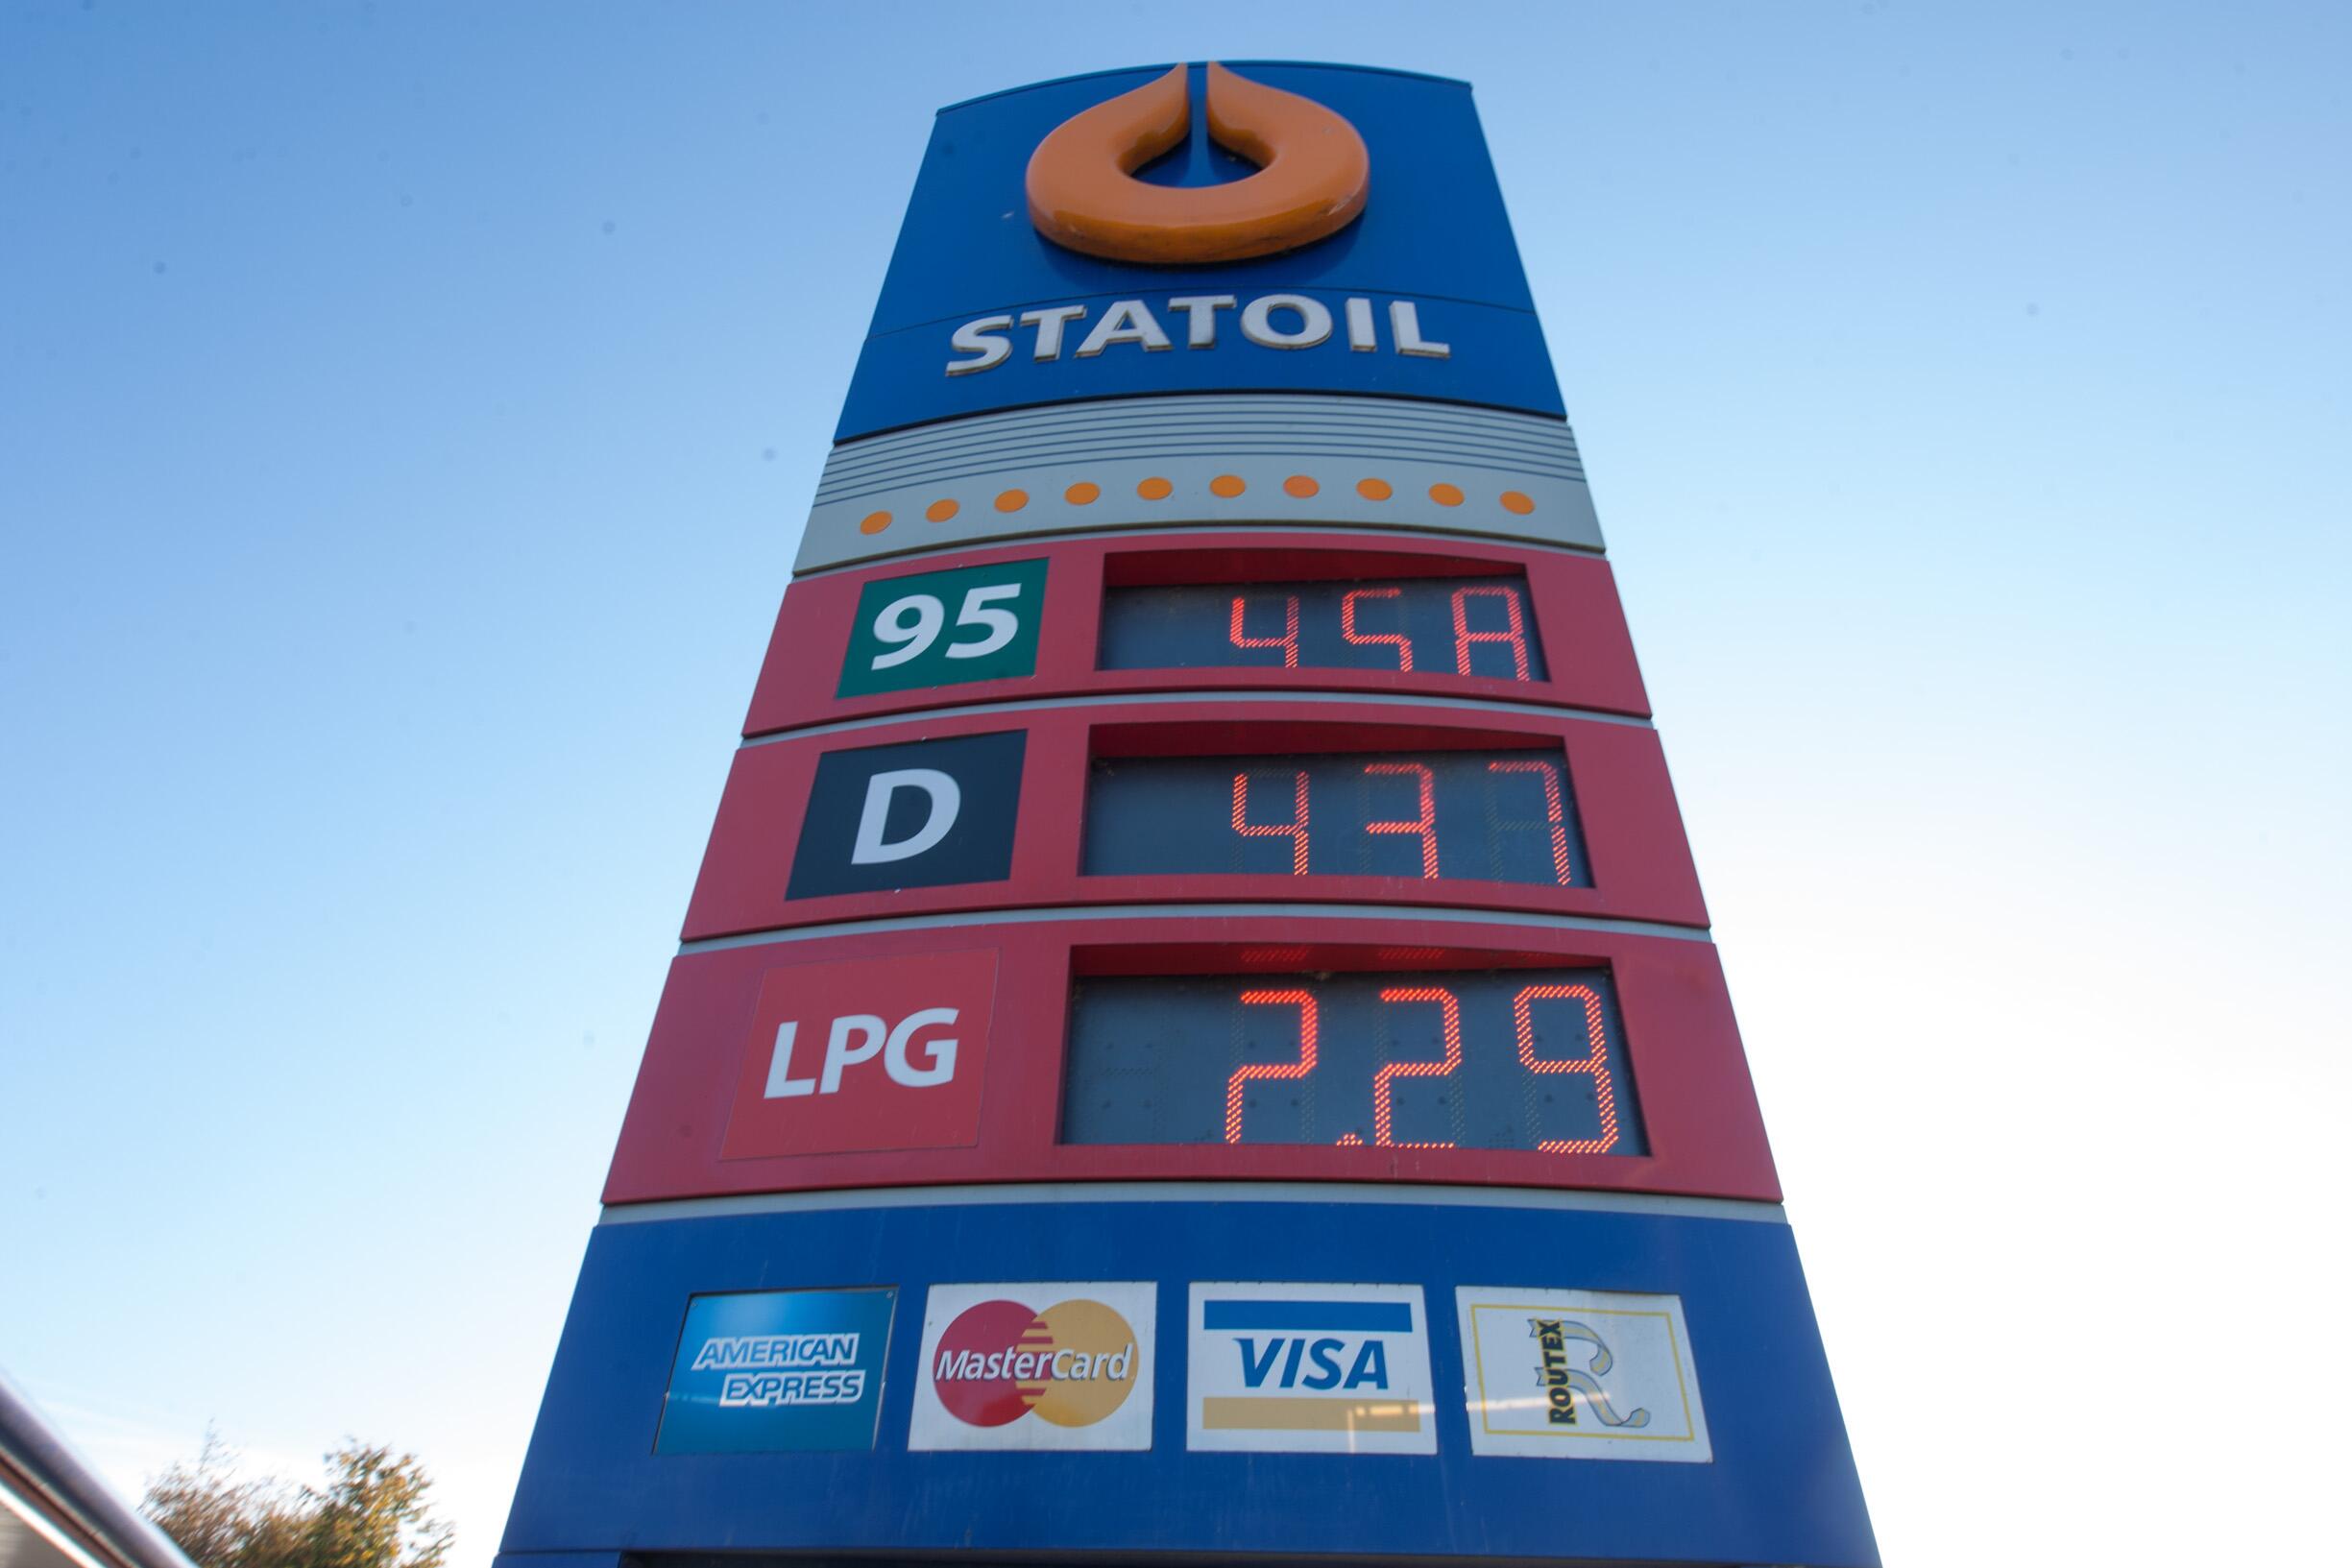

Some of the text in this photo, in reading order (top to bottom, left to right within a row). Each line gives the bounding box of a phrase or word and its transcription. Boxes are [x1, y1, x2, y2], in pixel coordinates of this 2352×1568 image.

[946, 294, 1451, 376] STATOIL
[871, 583, 1022, 670] 95
[851, 768, 960, 864] D
[764, 1007, 959, 1098] LPG
[1225, 985, 1618, 1152] 2.29
[691, 1333, 860, 1370] AMERICAN
[719, 1369, 866, 1407] EXPRESS
[935, 1343, 1133, 1383] MasterCard
[1233, 1338, 1390, 1390] VISA
[1537, 1317, 1578, 1426] ROUTEX
